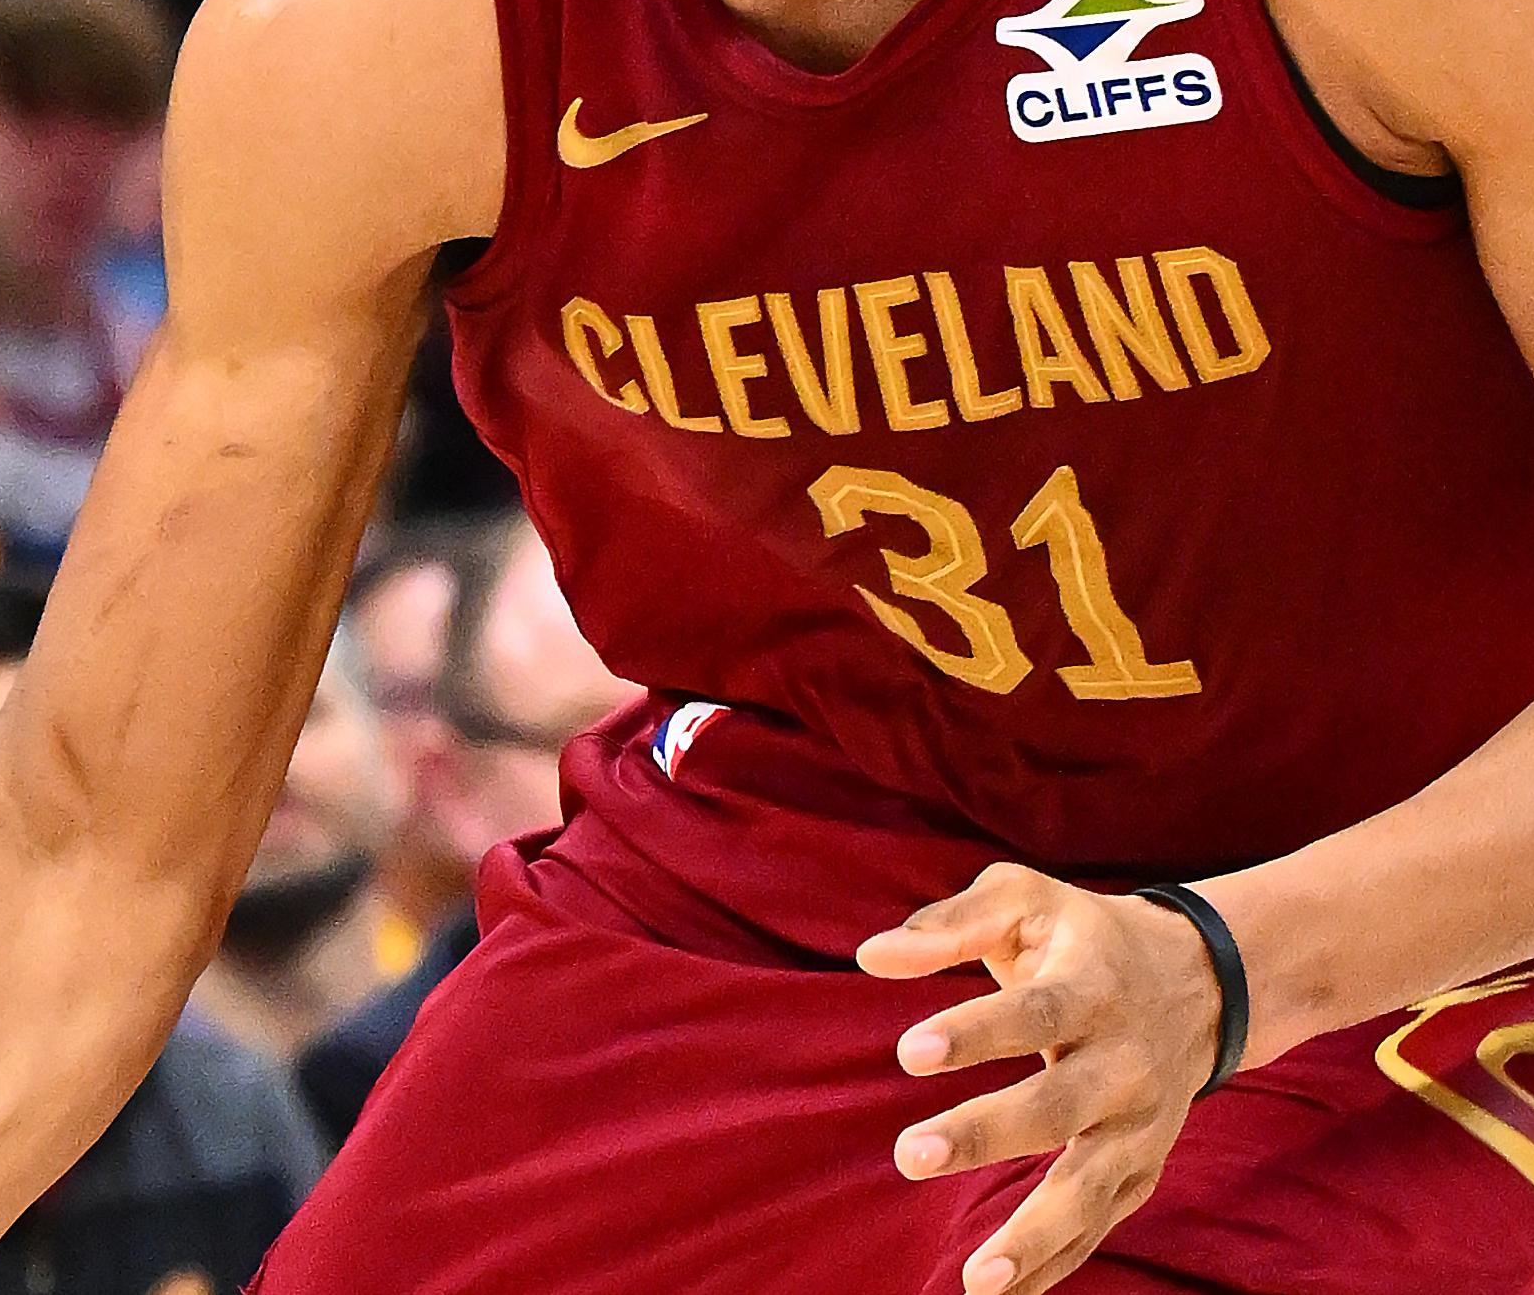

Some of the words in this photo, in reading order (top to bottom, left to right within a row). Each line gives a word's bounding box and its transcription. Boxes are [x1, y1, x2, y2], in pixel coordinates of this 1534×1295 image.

[1016, 69, 1212, 128] CLIFFS
[560, 246, 1272, 439] CLEVELAND
[806, 464, 1202, 701] 31
